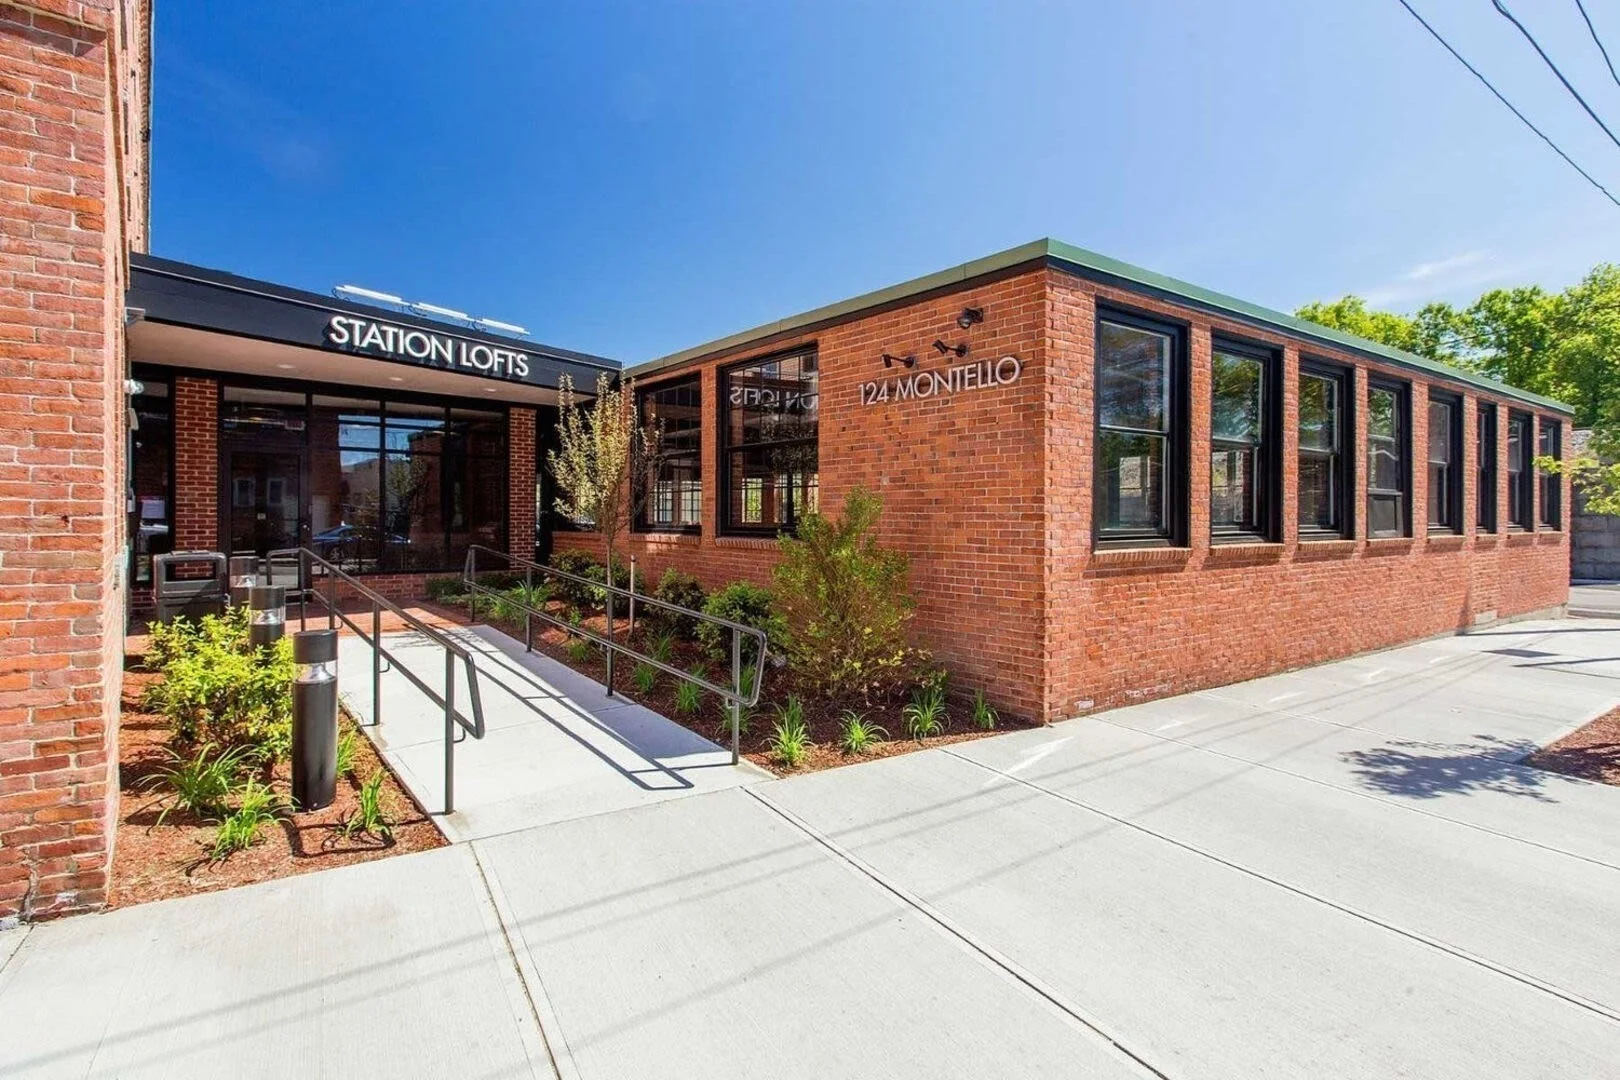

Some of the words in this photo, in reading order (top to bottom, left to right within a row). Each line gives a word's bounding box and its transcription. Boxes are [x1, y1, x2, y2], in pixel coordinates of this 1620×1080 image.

[329, 316, 452, 363] STATION
[459, 342, 529, 376] LOFTS
[858, 380, 890, 406] 124
[895, 356, 1021, 401] MONTELLO
